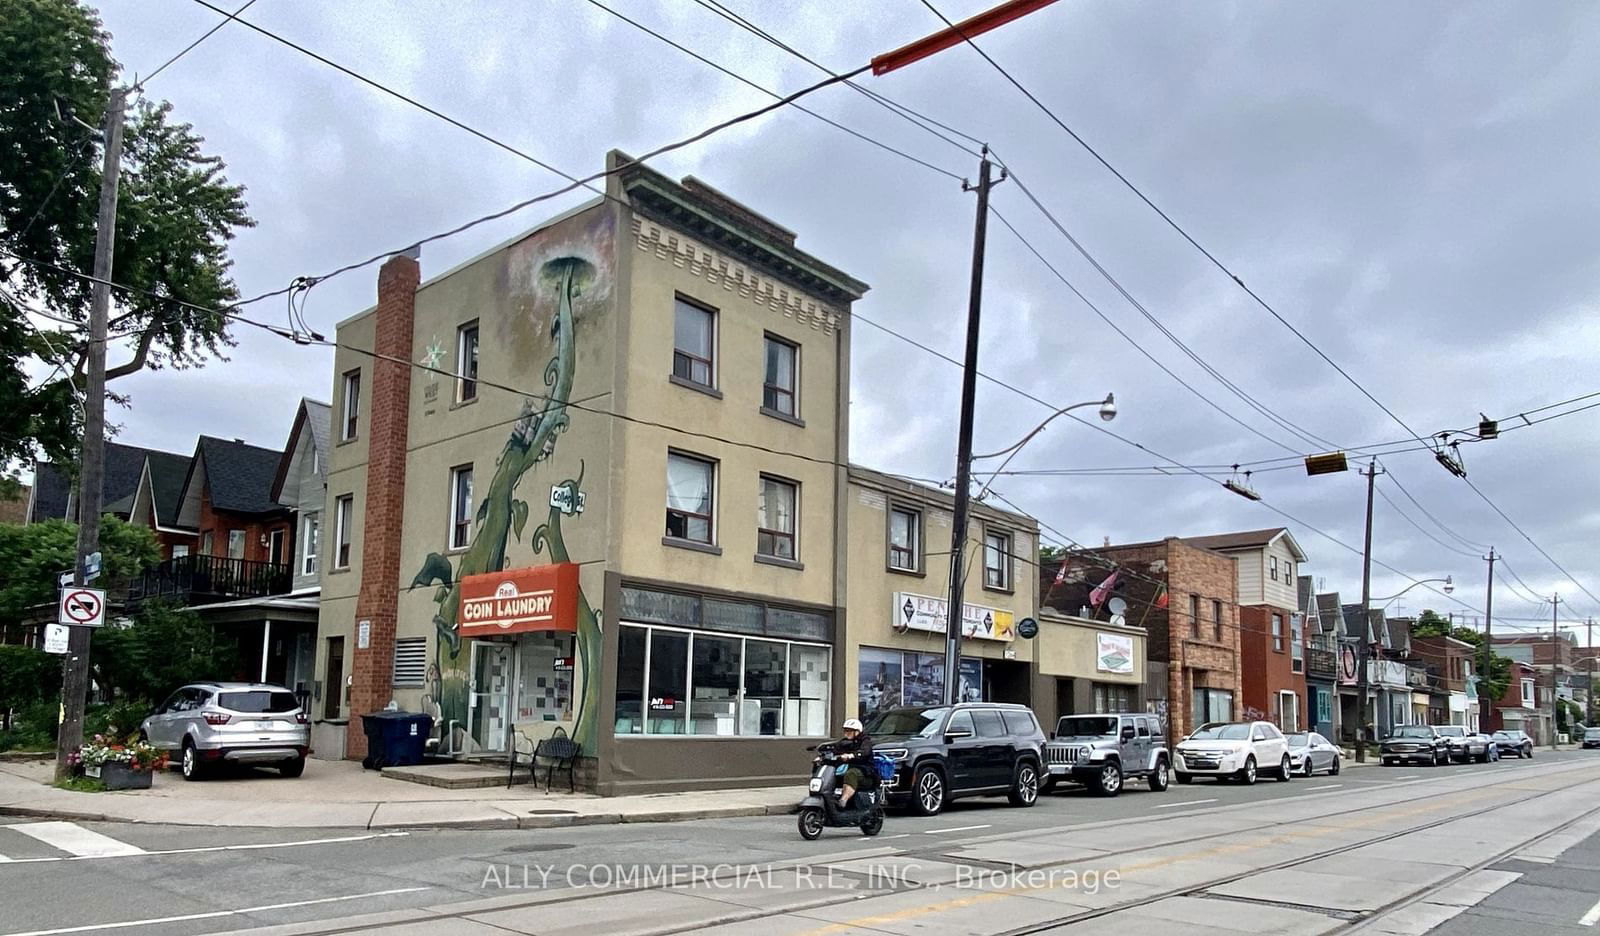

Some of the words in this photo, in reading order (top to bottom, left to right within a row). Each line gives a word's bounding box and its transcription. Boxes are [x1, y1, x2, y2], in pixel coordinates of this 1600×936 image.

[499, 588, 515, 597] Real
[463, 602, 493, 620] COIN
[497, 596, 552, 617] LAUNDRY
[917, 598, 981, 619] PENHE
